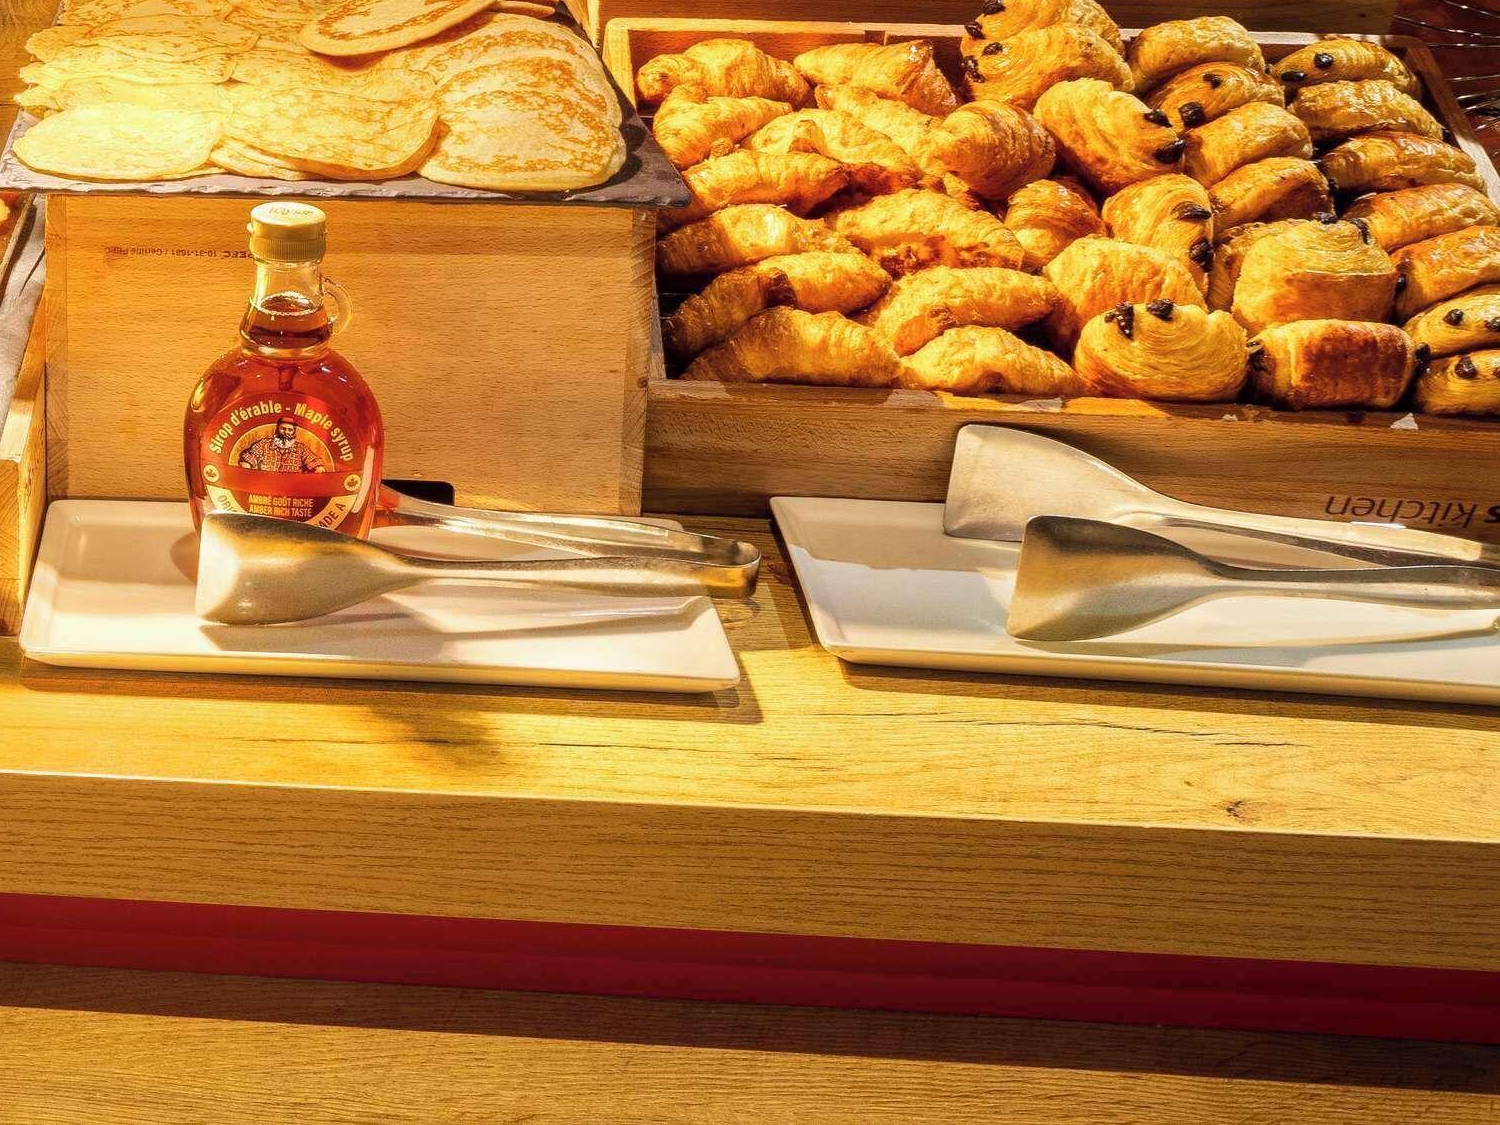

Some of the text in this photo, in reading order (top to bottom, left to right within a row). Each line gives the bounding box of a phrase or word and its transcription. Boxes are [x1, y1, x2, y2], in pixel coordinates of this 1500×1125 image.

[209, 421, 234, 454] Sirop
[230, 400, 282, 427] d'érable
[294, 403, 333, 429] Maple
[330, 427, 354, 462] syrup
[248, 493, 272, 505] AMBRÉ
[273, 495, 291, 507] GOÛT
[292, 498, 314, 508] RICHE
[335, 503, 346, 511] A
[249, 504, 312, 518] AMBER RICH TASTE
[1324, 495, 1478, 528] kitchen
